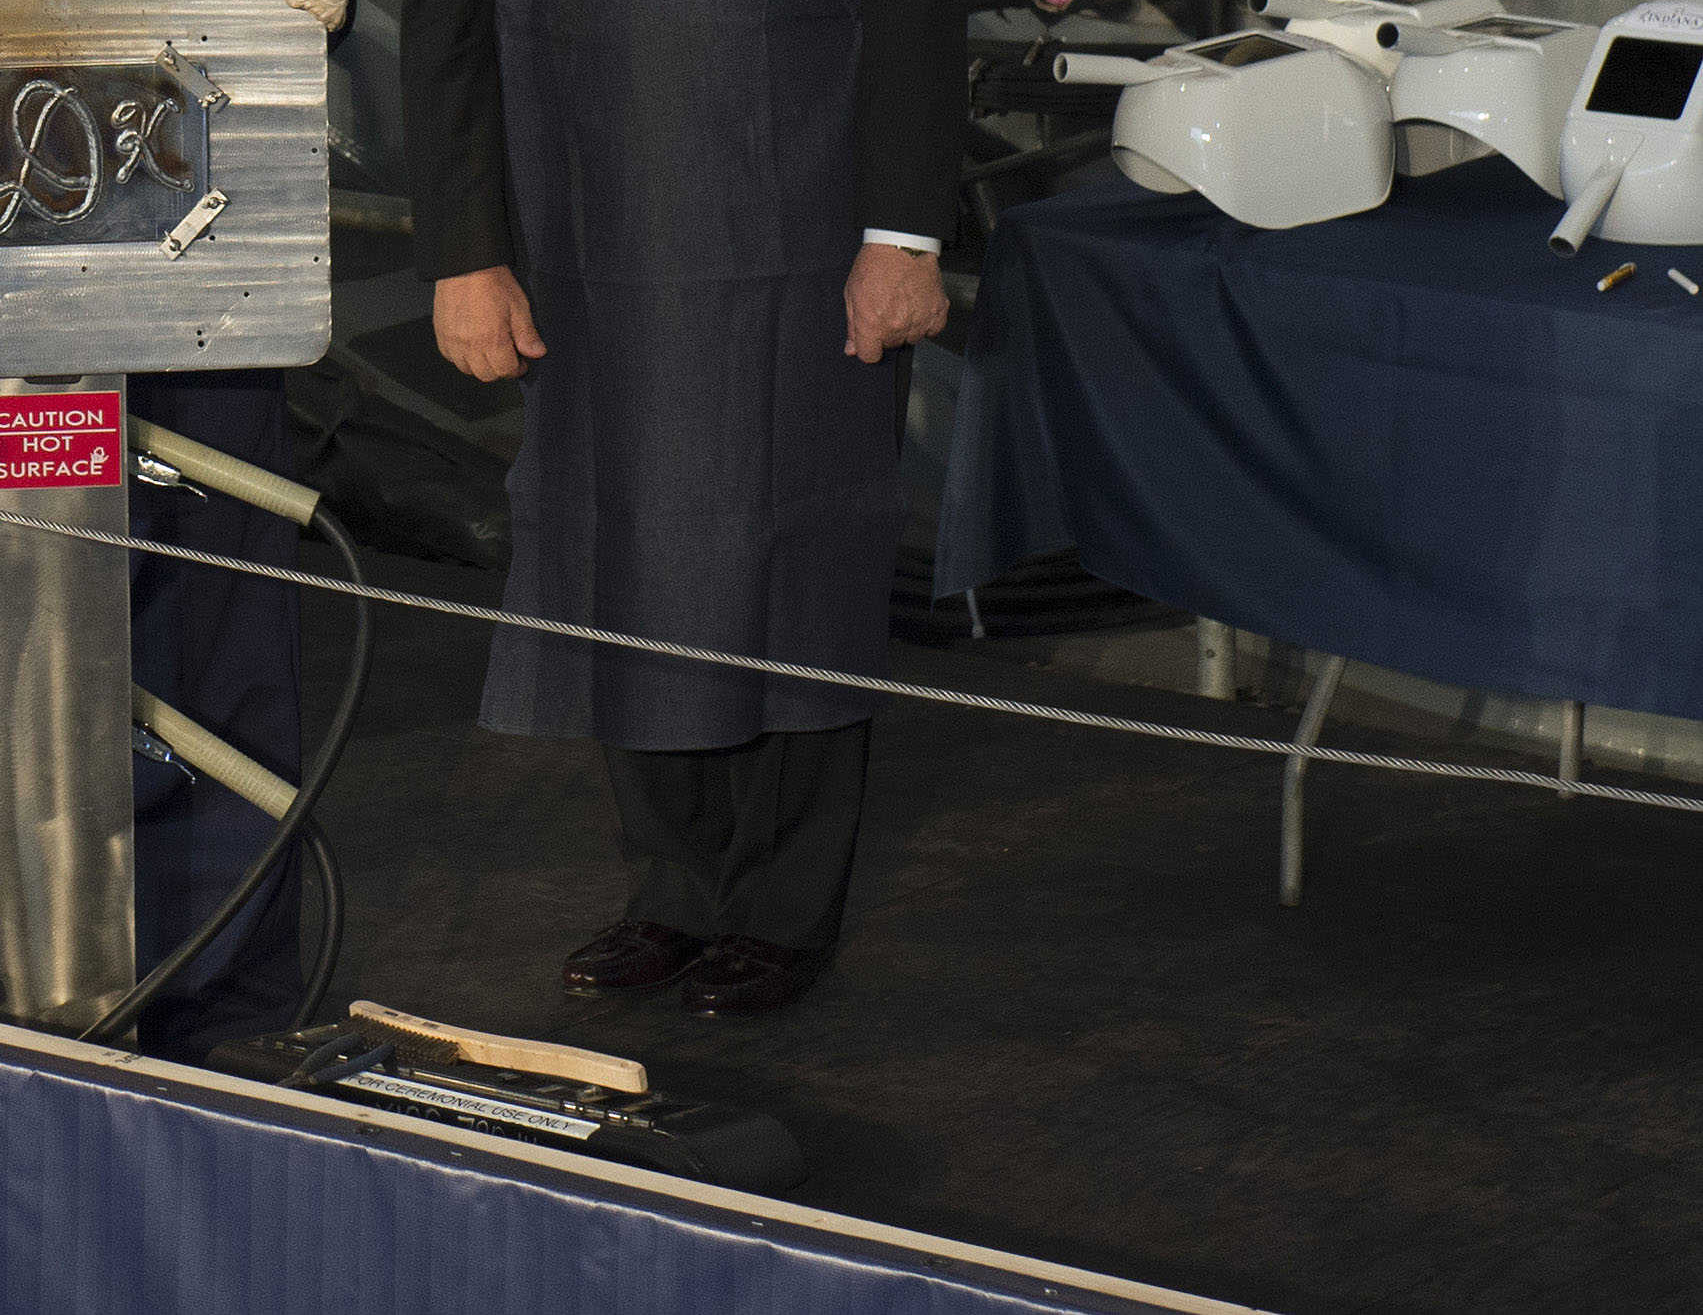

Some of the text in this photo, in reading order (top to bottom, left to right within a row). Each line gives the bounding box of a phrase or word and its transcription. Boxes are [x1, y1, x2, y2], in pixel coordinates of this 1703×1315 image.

[22, 435, 74, 453] HOT
[347, 1074, 385, 1088] FOR
[385, 1082, 488, 1113] CEREMONIAL
[490, 1106, 529, 1120] USE
[528, 1115, 570, 1131] ONLY
